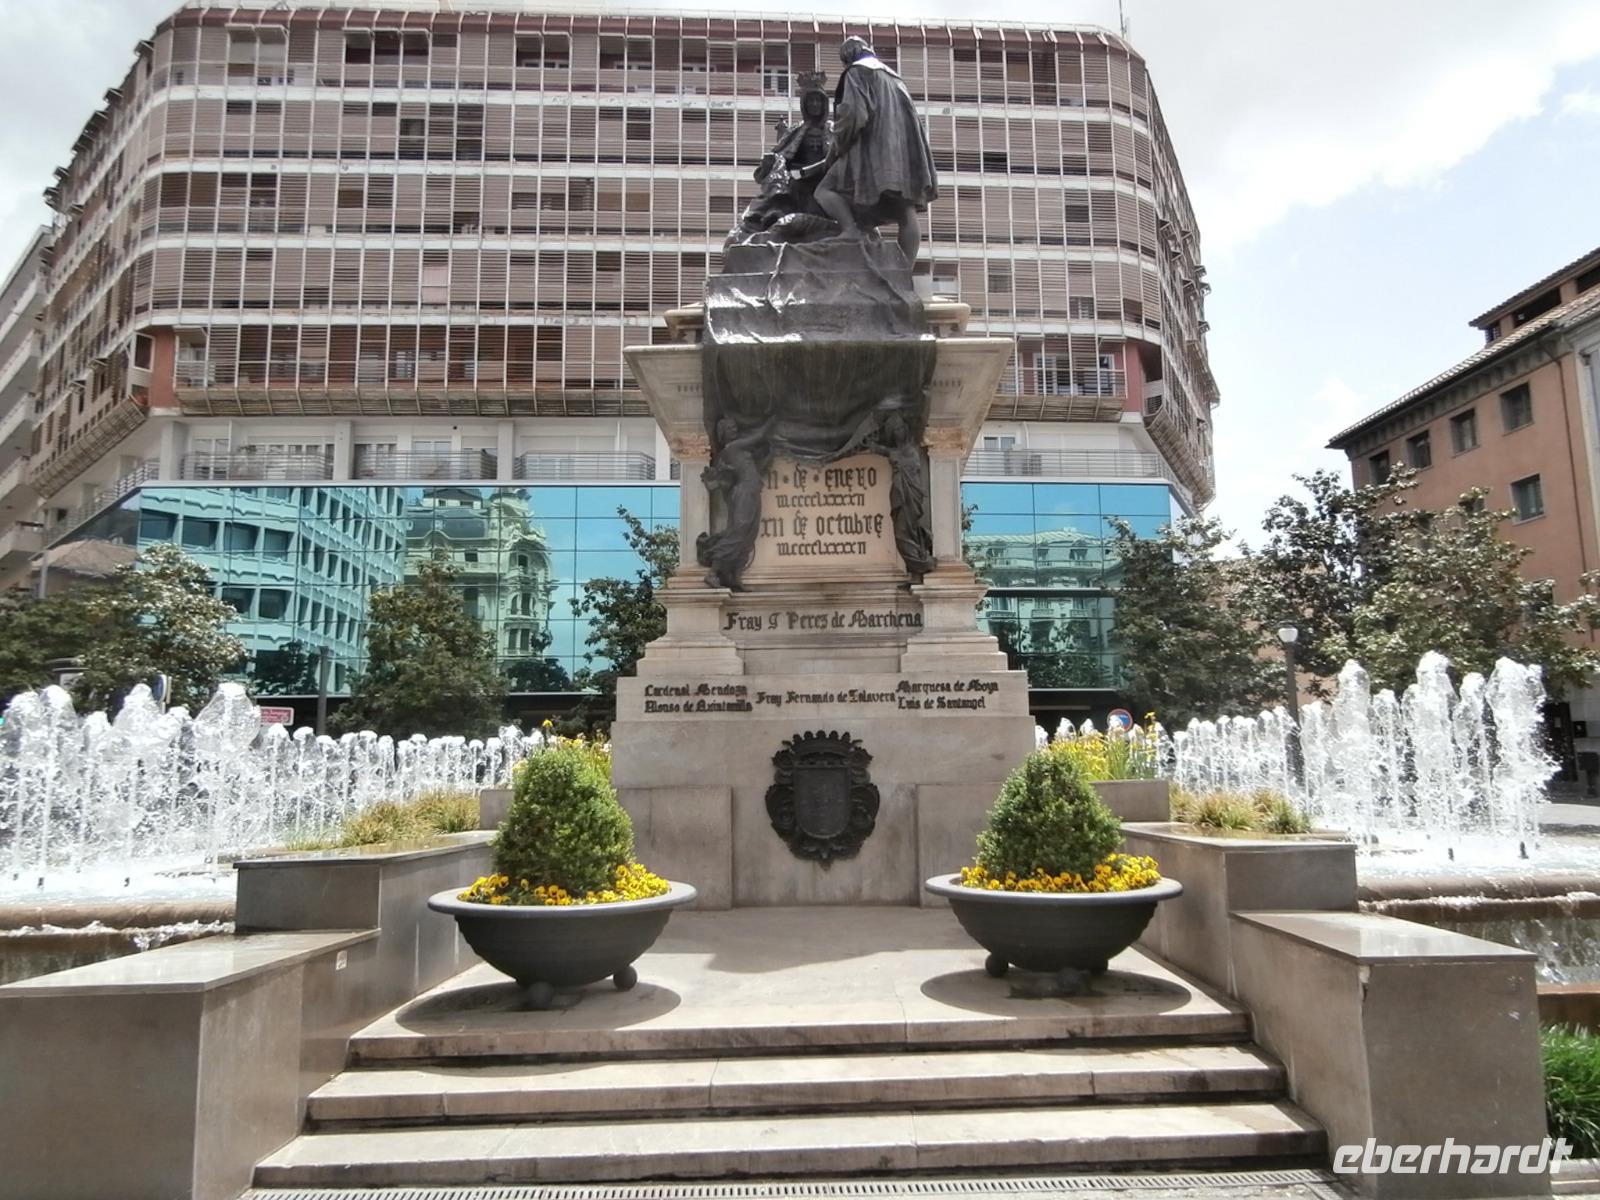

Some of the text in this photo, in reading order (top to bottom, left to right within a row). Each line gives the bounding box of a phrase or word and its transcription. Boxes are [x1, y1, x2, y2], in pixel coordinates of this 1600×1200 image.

[723, 608, 762, 631] Fray
[831, 611, 845, 628] de
[954, 680, 965, 692] de
[837, 691, 847, 702] de
[683, 701, 694, 712] de
[924, 698, 934, 709] de
